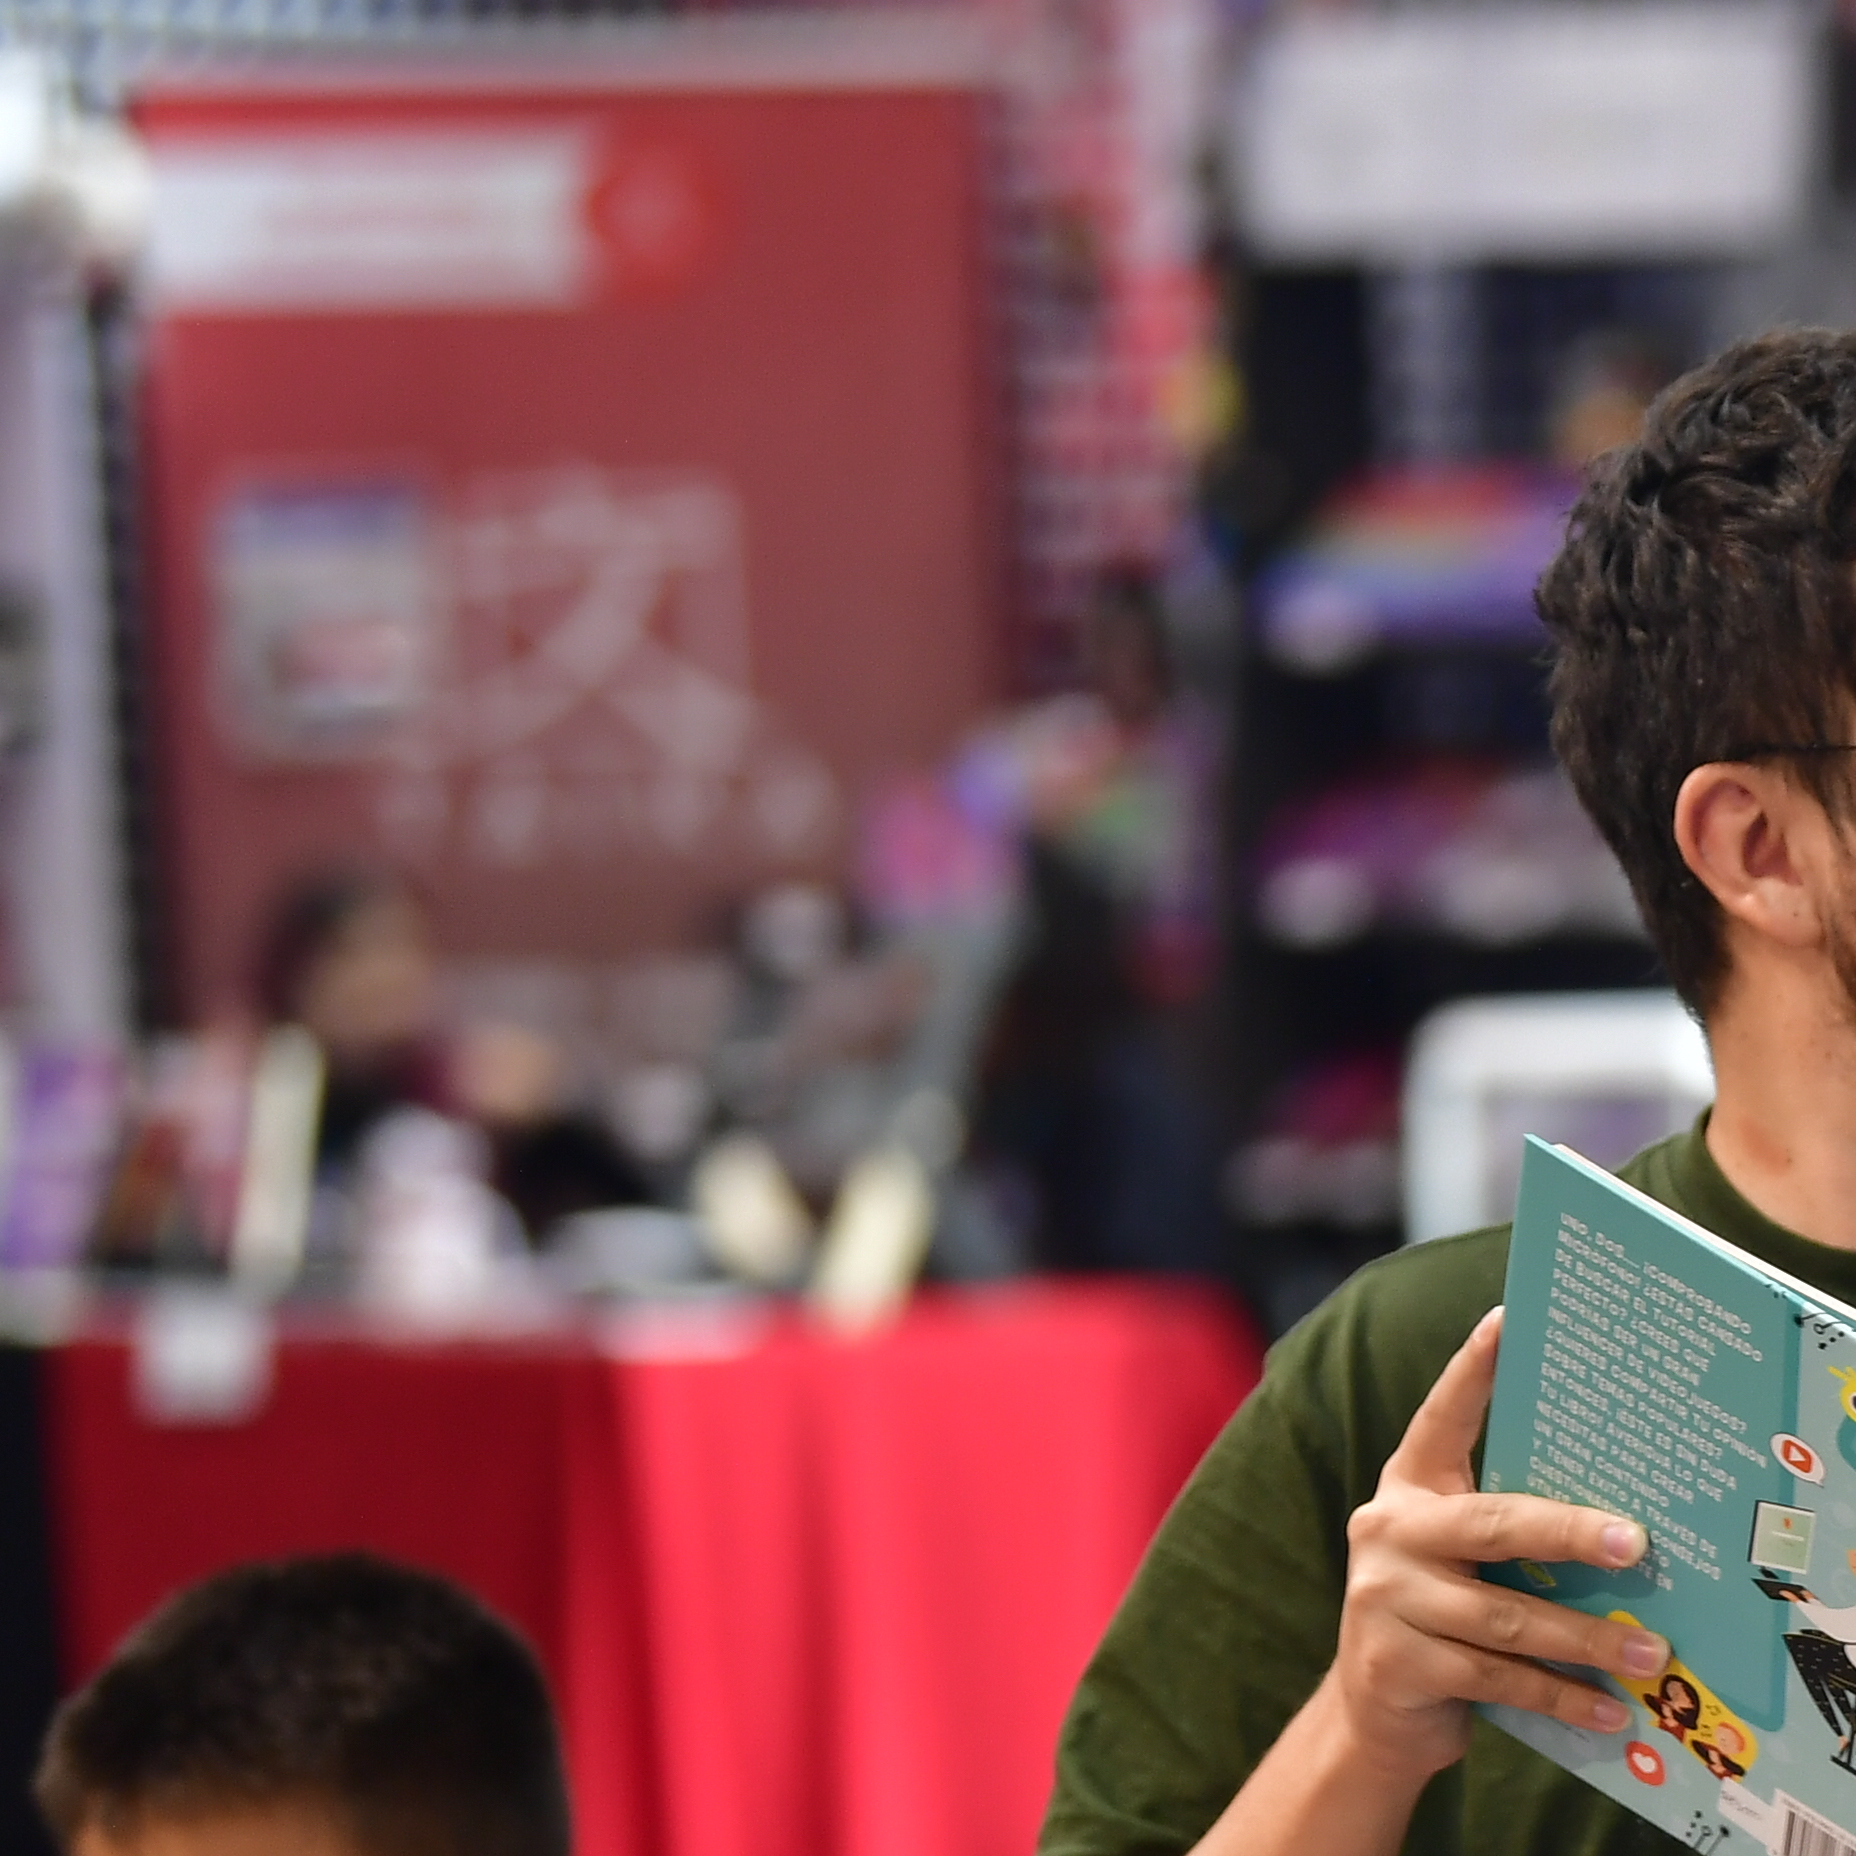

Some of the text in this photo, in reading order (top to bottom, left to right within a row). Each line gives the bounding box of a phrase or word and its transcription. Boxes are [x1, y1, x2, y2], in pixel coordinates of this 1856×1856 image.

[1553, 1268, 1628, 1321] PERFECTO?
[1683, 1348, 1710, 1373] QUE
[1555, 1248, 1717, 1357] DE BUSCAR EL TUTORIAL
[1613, 1324, 1638, 1349] SER
[1641, 1343, 1661, 1362] UN
[1697, 1315, 1763, 1362] CANSADO
[1543, 1343, 1723, 1461] SOBRE TEMAS POPULARES?
[1547, 1306, 1748, 1435] INFLUENCER DE VIDEOJUEGOS?
[1610, 1364, 1689, 1421] COMPARTIR
[1691, 1412, 1711, 1433] TU
[1536, 1399, 1695, 1504] NECESITAS PARA CREAR
[1539, 1379, 1559, 1400] TU
[1674, 1464, 1694, 1482] LO
[1697, 1478, 1723, 1502] QUE
[1594, 1455, 1670, 1508] CONTENIDO
[1655, 1431, 1673, 1451] ES
[1532, 1436, 1543, 1450] Y
[1630, 1498, 1641, 1512] A
[1699, 1538, 1718, 1559] DE
